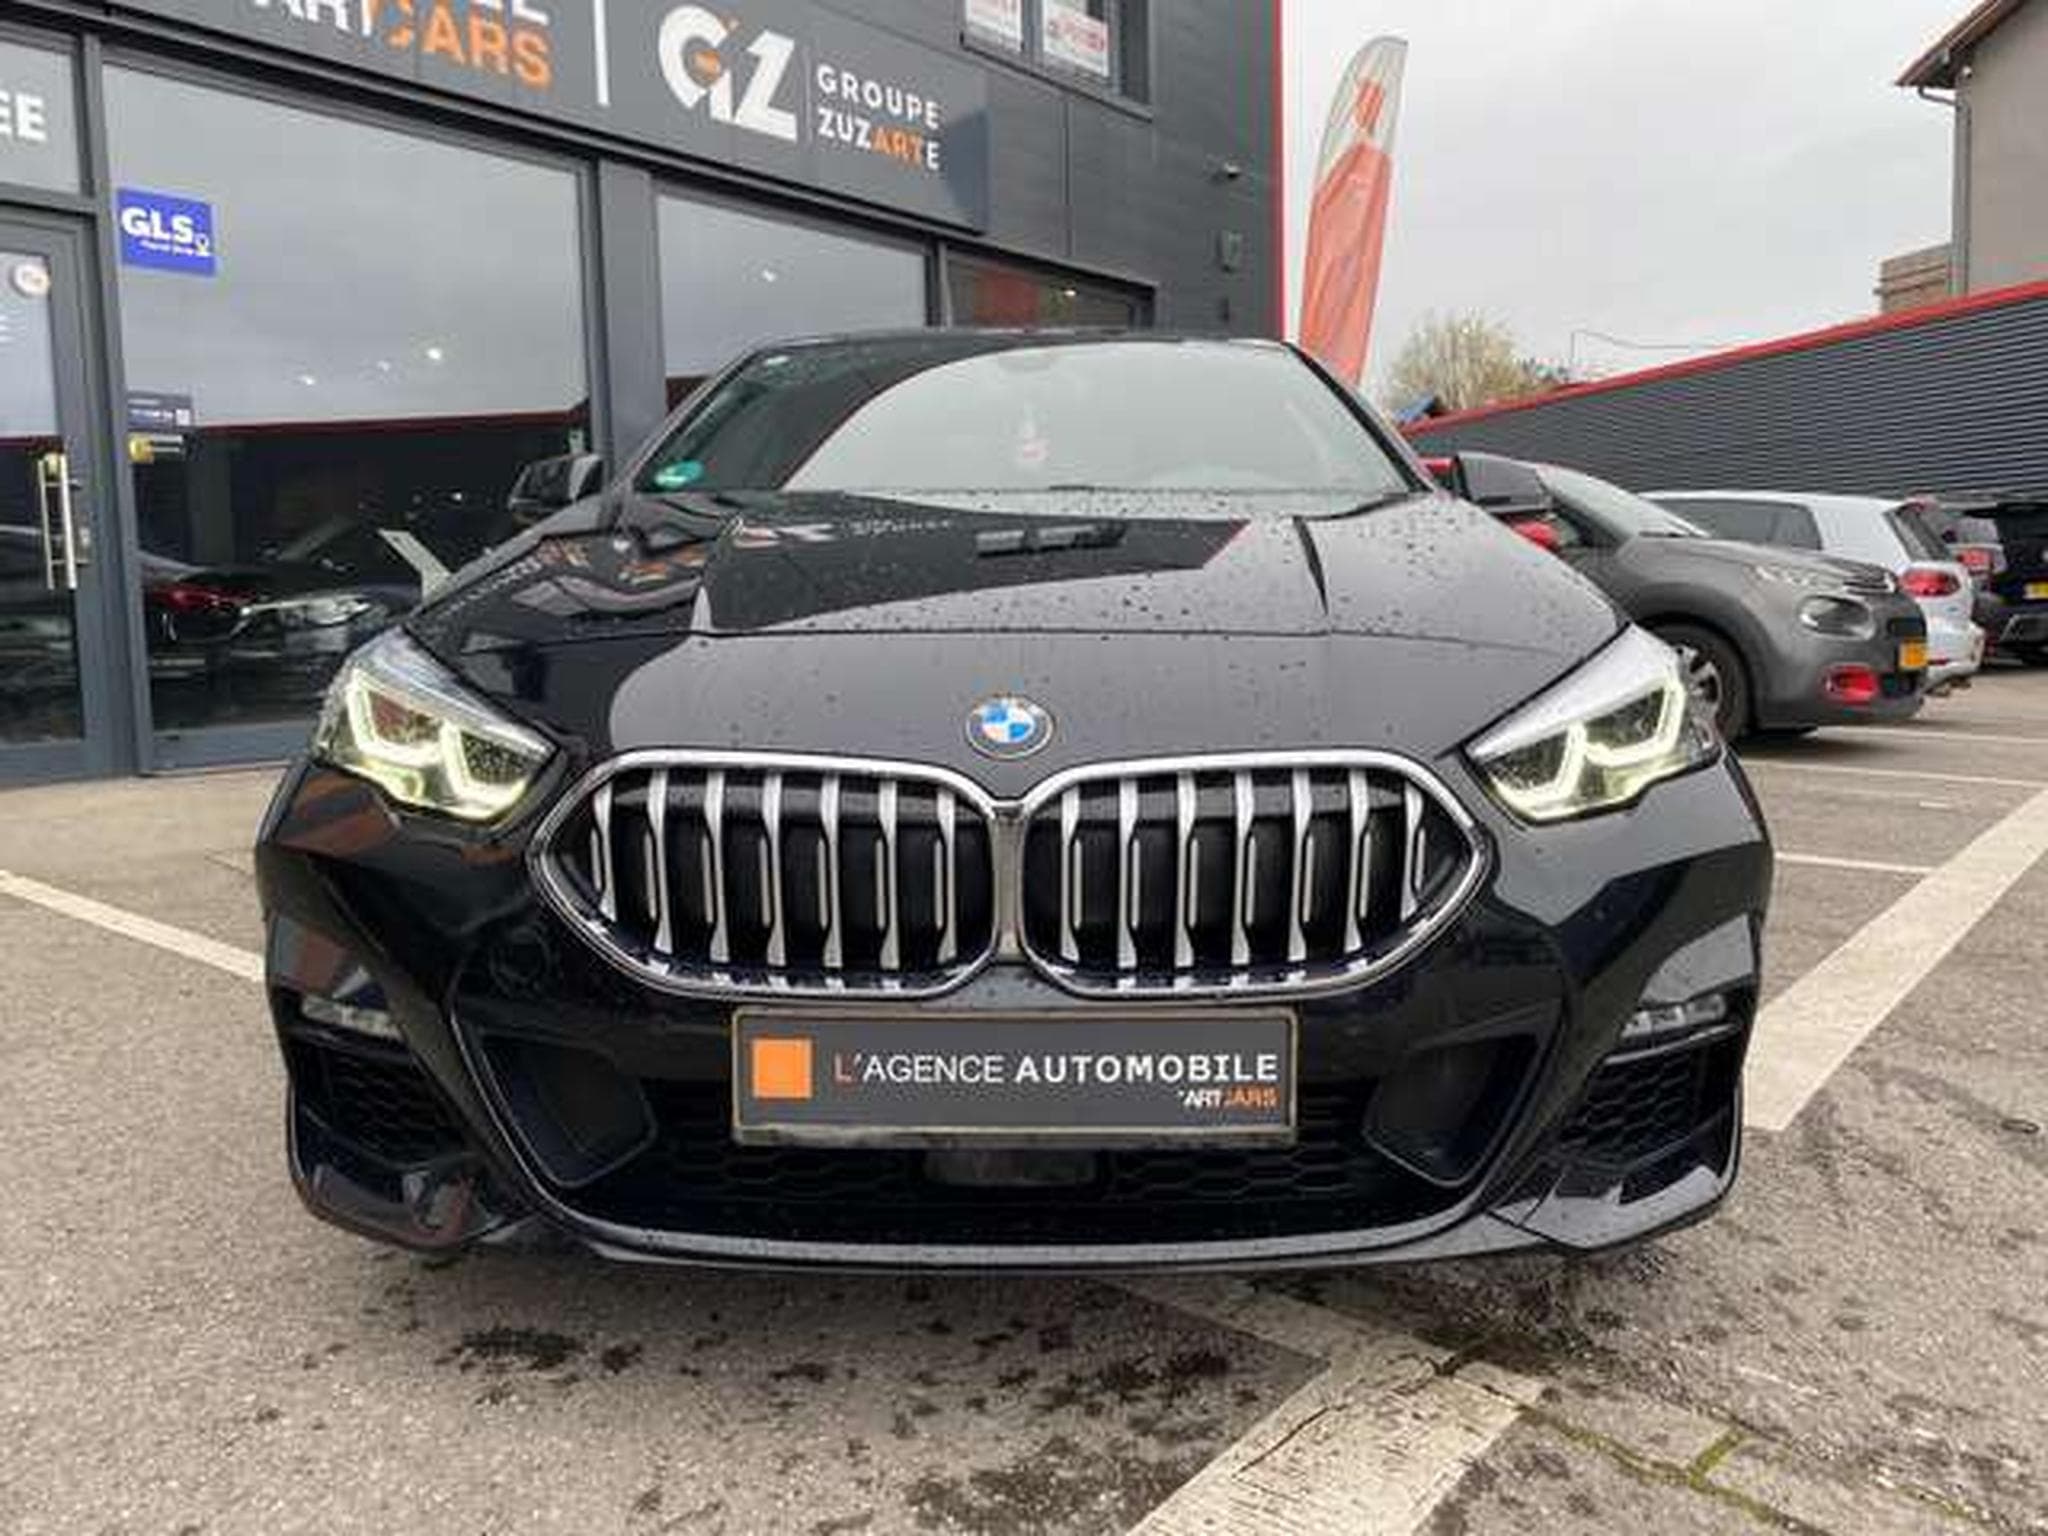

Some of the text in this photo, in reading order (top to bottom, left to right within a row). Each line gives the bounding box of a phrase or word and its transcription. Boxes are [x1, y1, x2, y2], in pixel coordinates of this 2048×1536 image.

[816, 63, 940, 130] GROUPE
[816, 107, 940, 171] ZUZARTE
[120, 206, 194, 244] GLS
[833, 1053, 1279, 1084] L'AGENCE AUTOMOBILE
